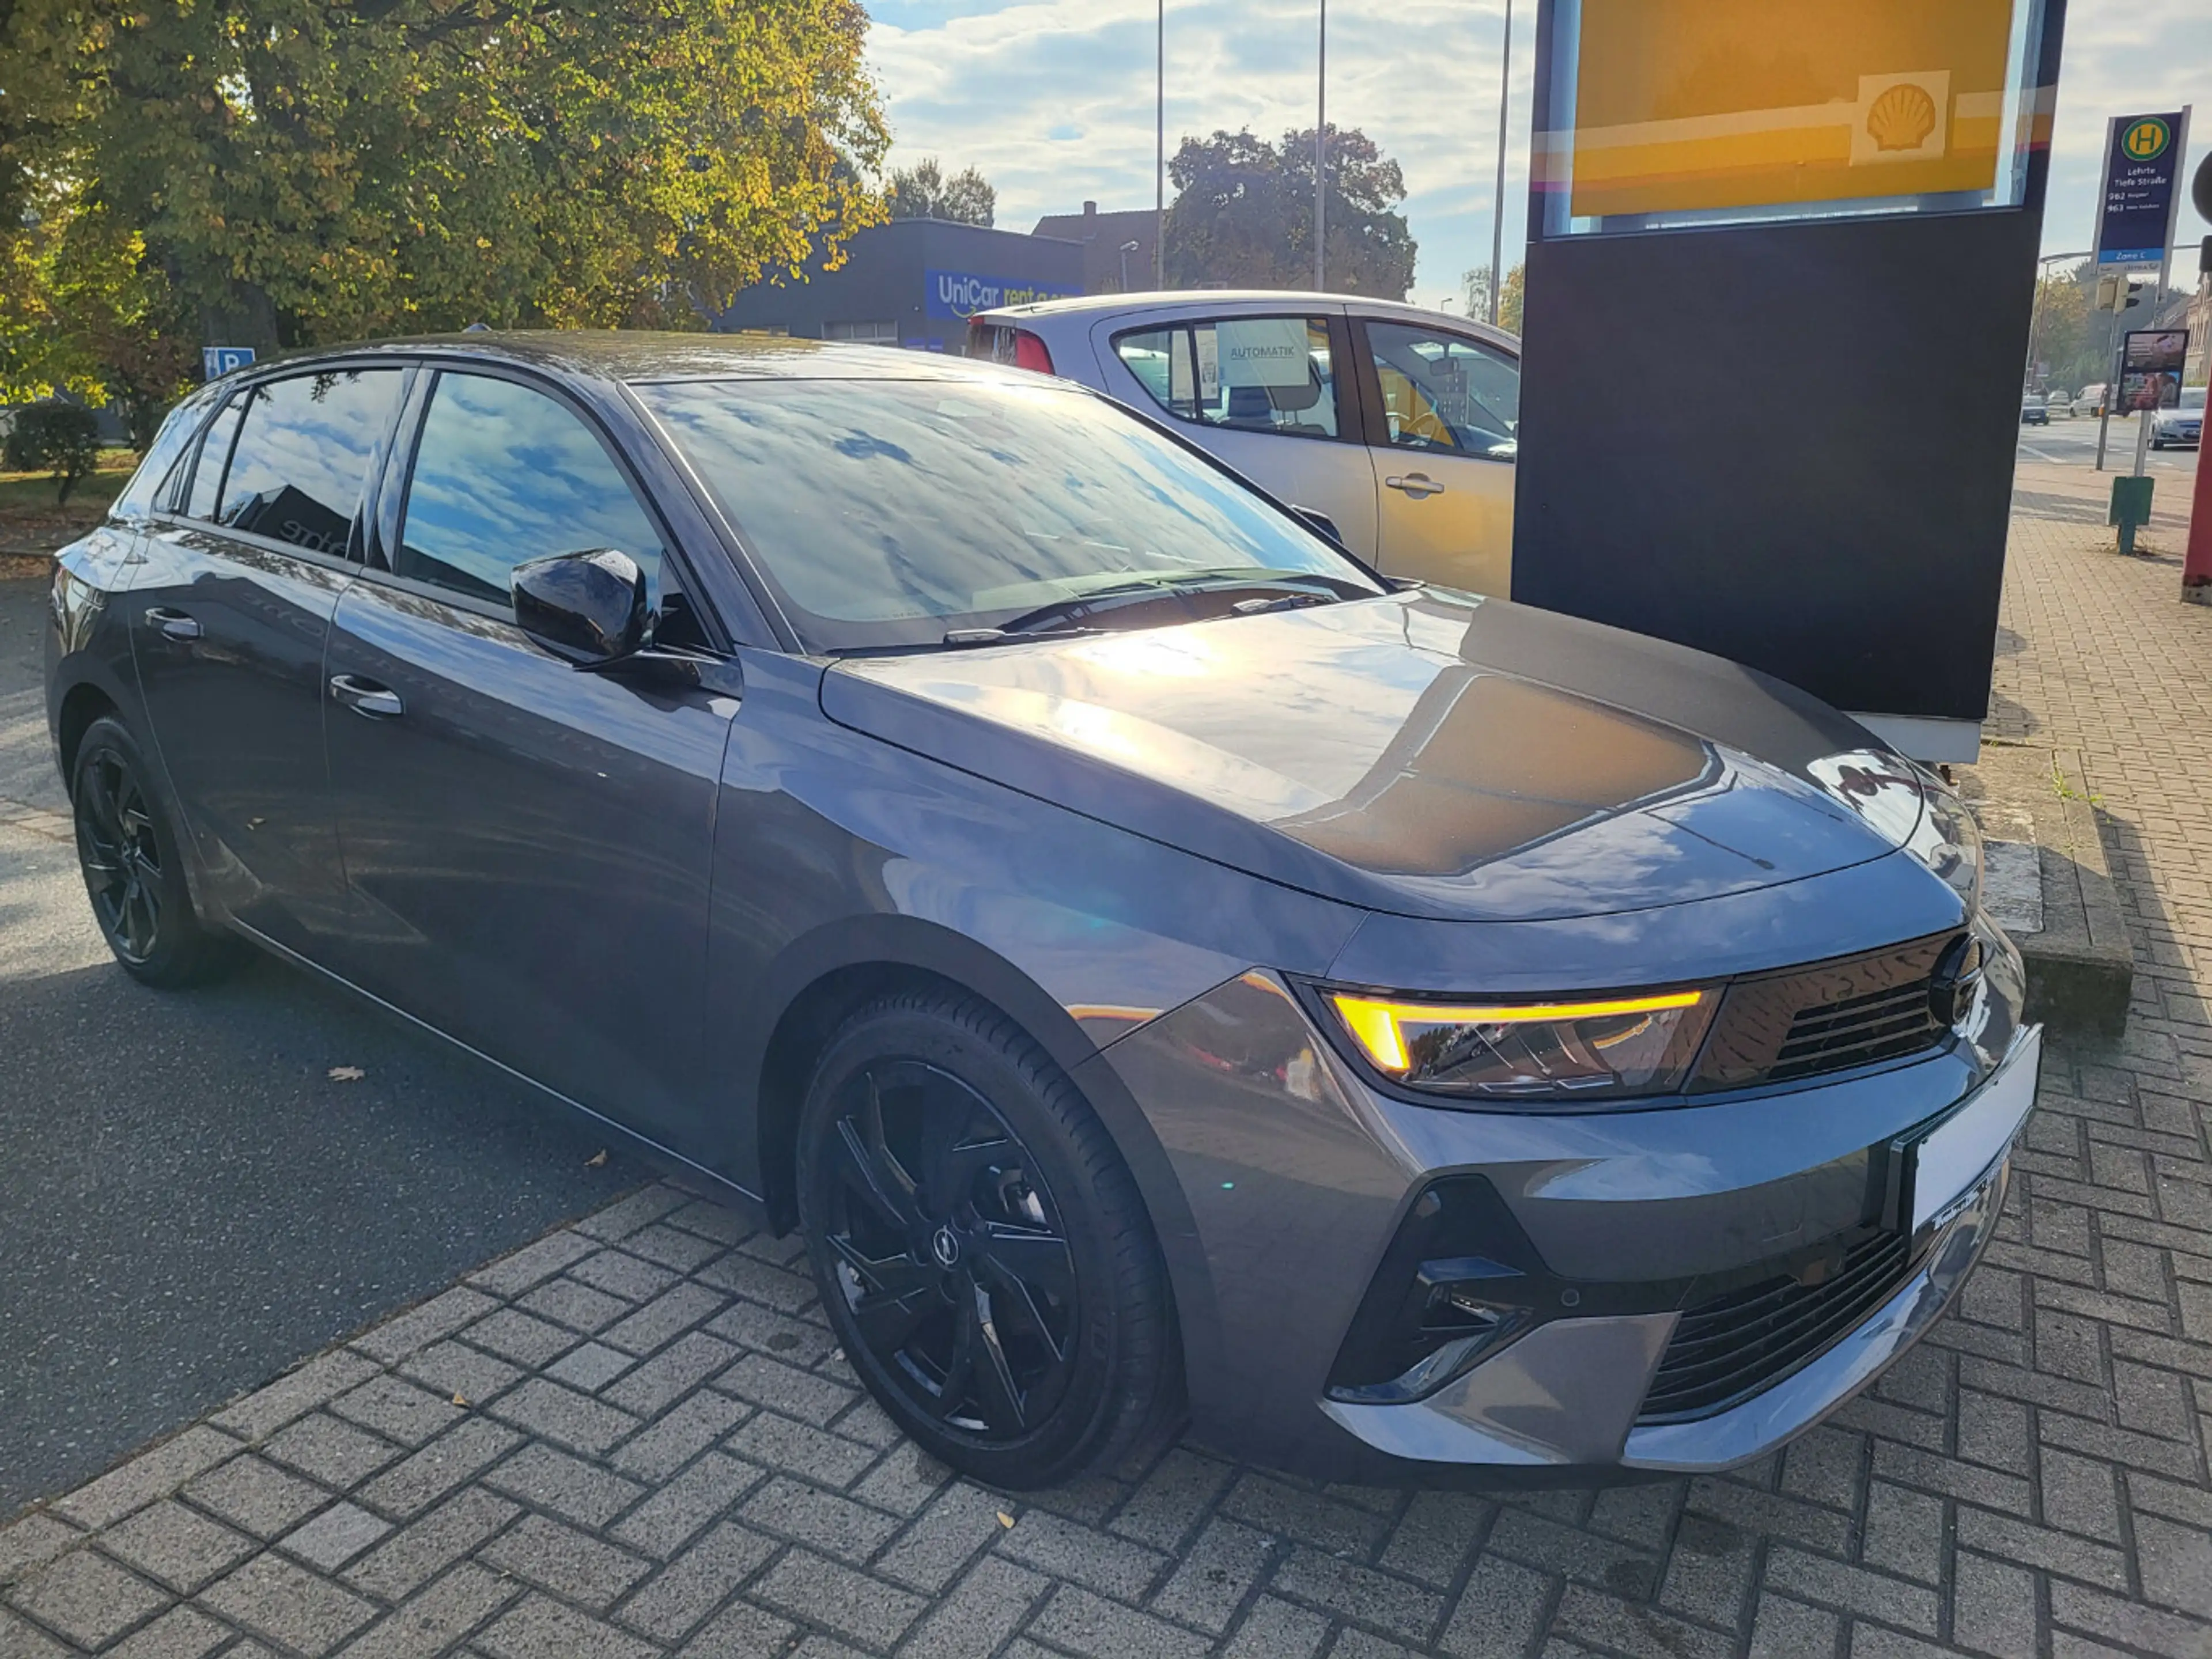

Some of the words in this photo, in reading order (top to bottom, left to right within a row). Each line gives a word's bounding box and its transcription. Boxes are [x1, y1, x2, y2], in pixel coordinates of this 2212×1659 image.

[2136, 126, 2156, 151] H
[2127, 166, 2156, 176] Lehrte
[2116, 252, 2138, 260] Zone
[939, 275, 999, 306] UniCar
[1004, 286, 1034, 306] rent
[1231, 346, 1295, 358] AUTOMATIK
[225, 353, 240, 372] P
